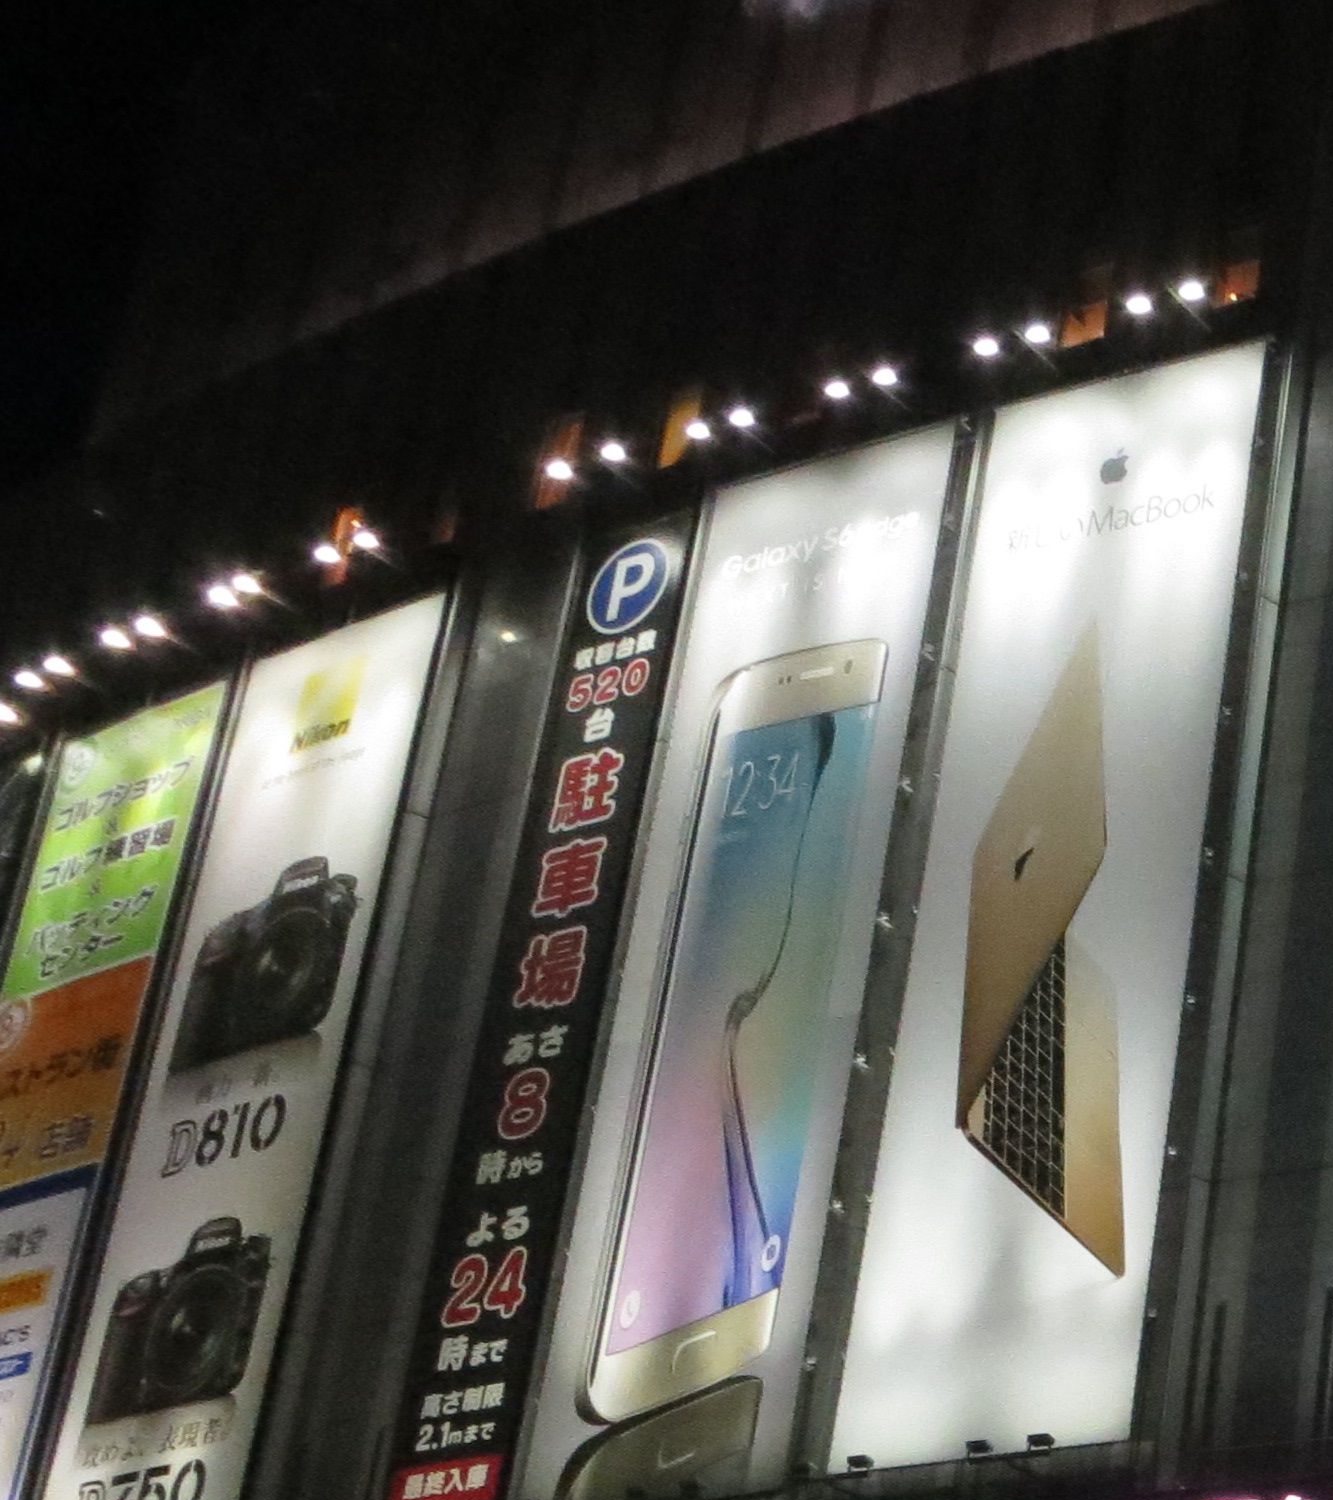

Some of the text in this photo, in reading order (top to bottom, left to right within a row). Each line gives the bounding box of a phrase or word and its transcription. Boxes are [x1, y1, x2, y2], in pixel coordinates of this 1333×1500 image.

[721, 535, 819, 581] Galaxy
[566, 658, 650, 712] 520
[513, 747, 624, 1008] 駐車場
[503, 1024, 570, 1068] あさ
[498, 1067, 550, 1140] 8
[161, 1094, 286, 1178] D810
[475, 1151, 545, 1185] 時から
[466, 1205, 531, 1248] よる
[440, 1246, 528, 1328] 24
[436, 1336, 508, 1373] 時まで
[415, 1421, 496, 1452] 2.1mまで
